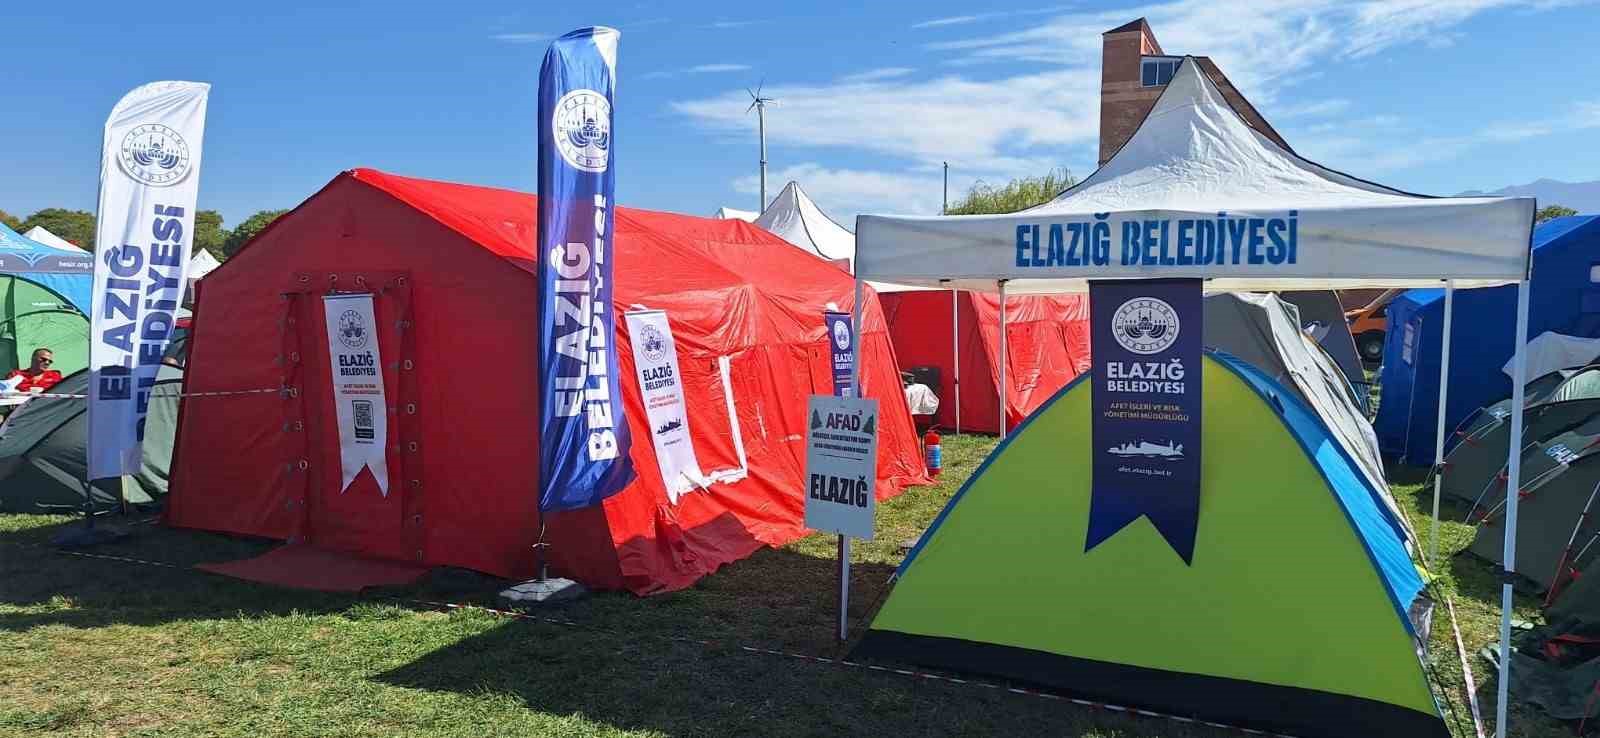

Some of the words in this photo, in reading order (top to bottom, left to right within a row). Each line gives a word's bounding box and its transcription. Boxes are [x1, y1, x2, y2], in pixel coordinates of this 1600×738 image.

[1015, 212, 1111, 268] ELAZIĞ
[1121, 210, 1298, 266] BELEDİYESİ
[99, 244, 144, 400] ELAZIĞ
[550, 242, 591, 417] ELAZIĞ
[339, 350, 374, 367] ELAZIĞ
[1106, 358, 1185, 380] ELAZIĞ
[340, 367, 376, 376] BELEDİYESİ
[642, 362, 673, 381] ELAZIĞ
[1107, 381, 1185, 394] BELEDİYESİ
[810, 473, 868, 508] ELAZIĞ
